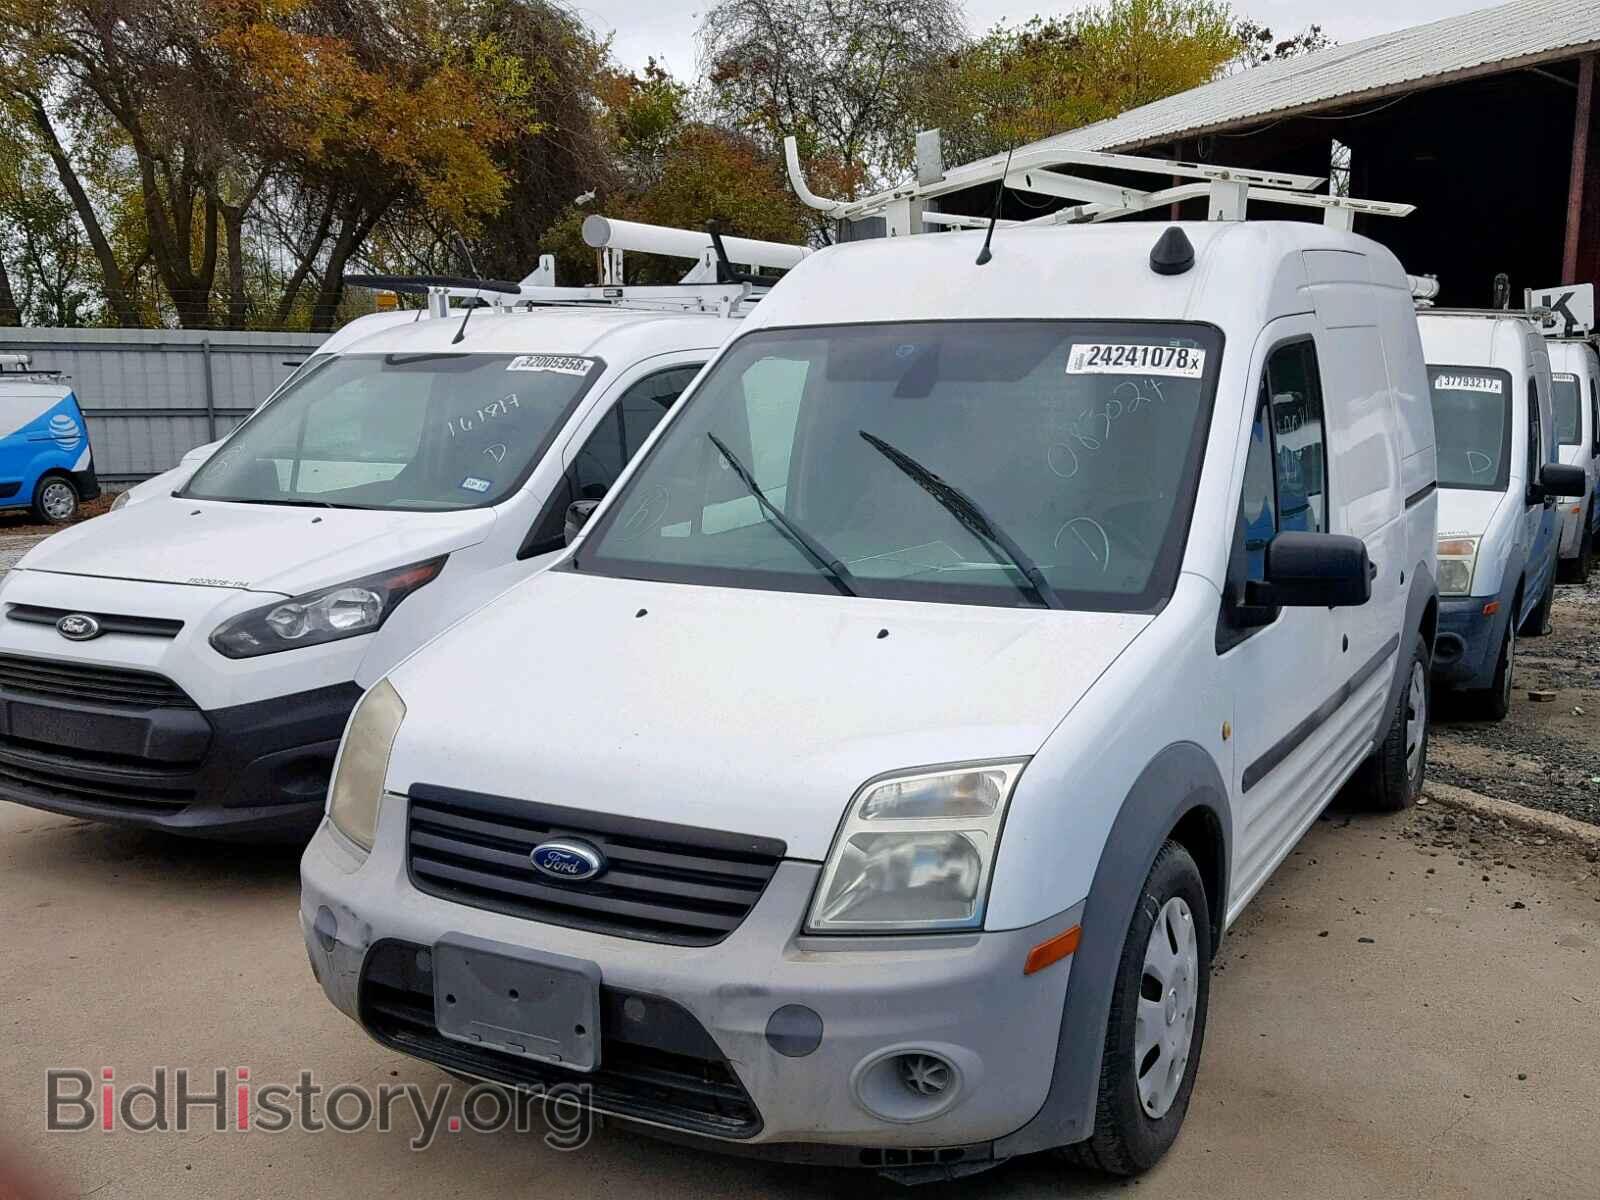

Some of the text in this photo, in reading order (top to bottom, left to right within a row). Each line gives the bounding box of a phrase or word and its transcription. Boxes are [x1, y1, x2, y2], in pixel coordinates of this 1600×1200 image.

[522, 356, 583, 370] 32005958
[1087, 345, 1190, 369] 24241078
[543, 851, 580, 873] Ford
